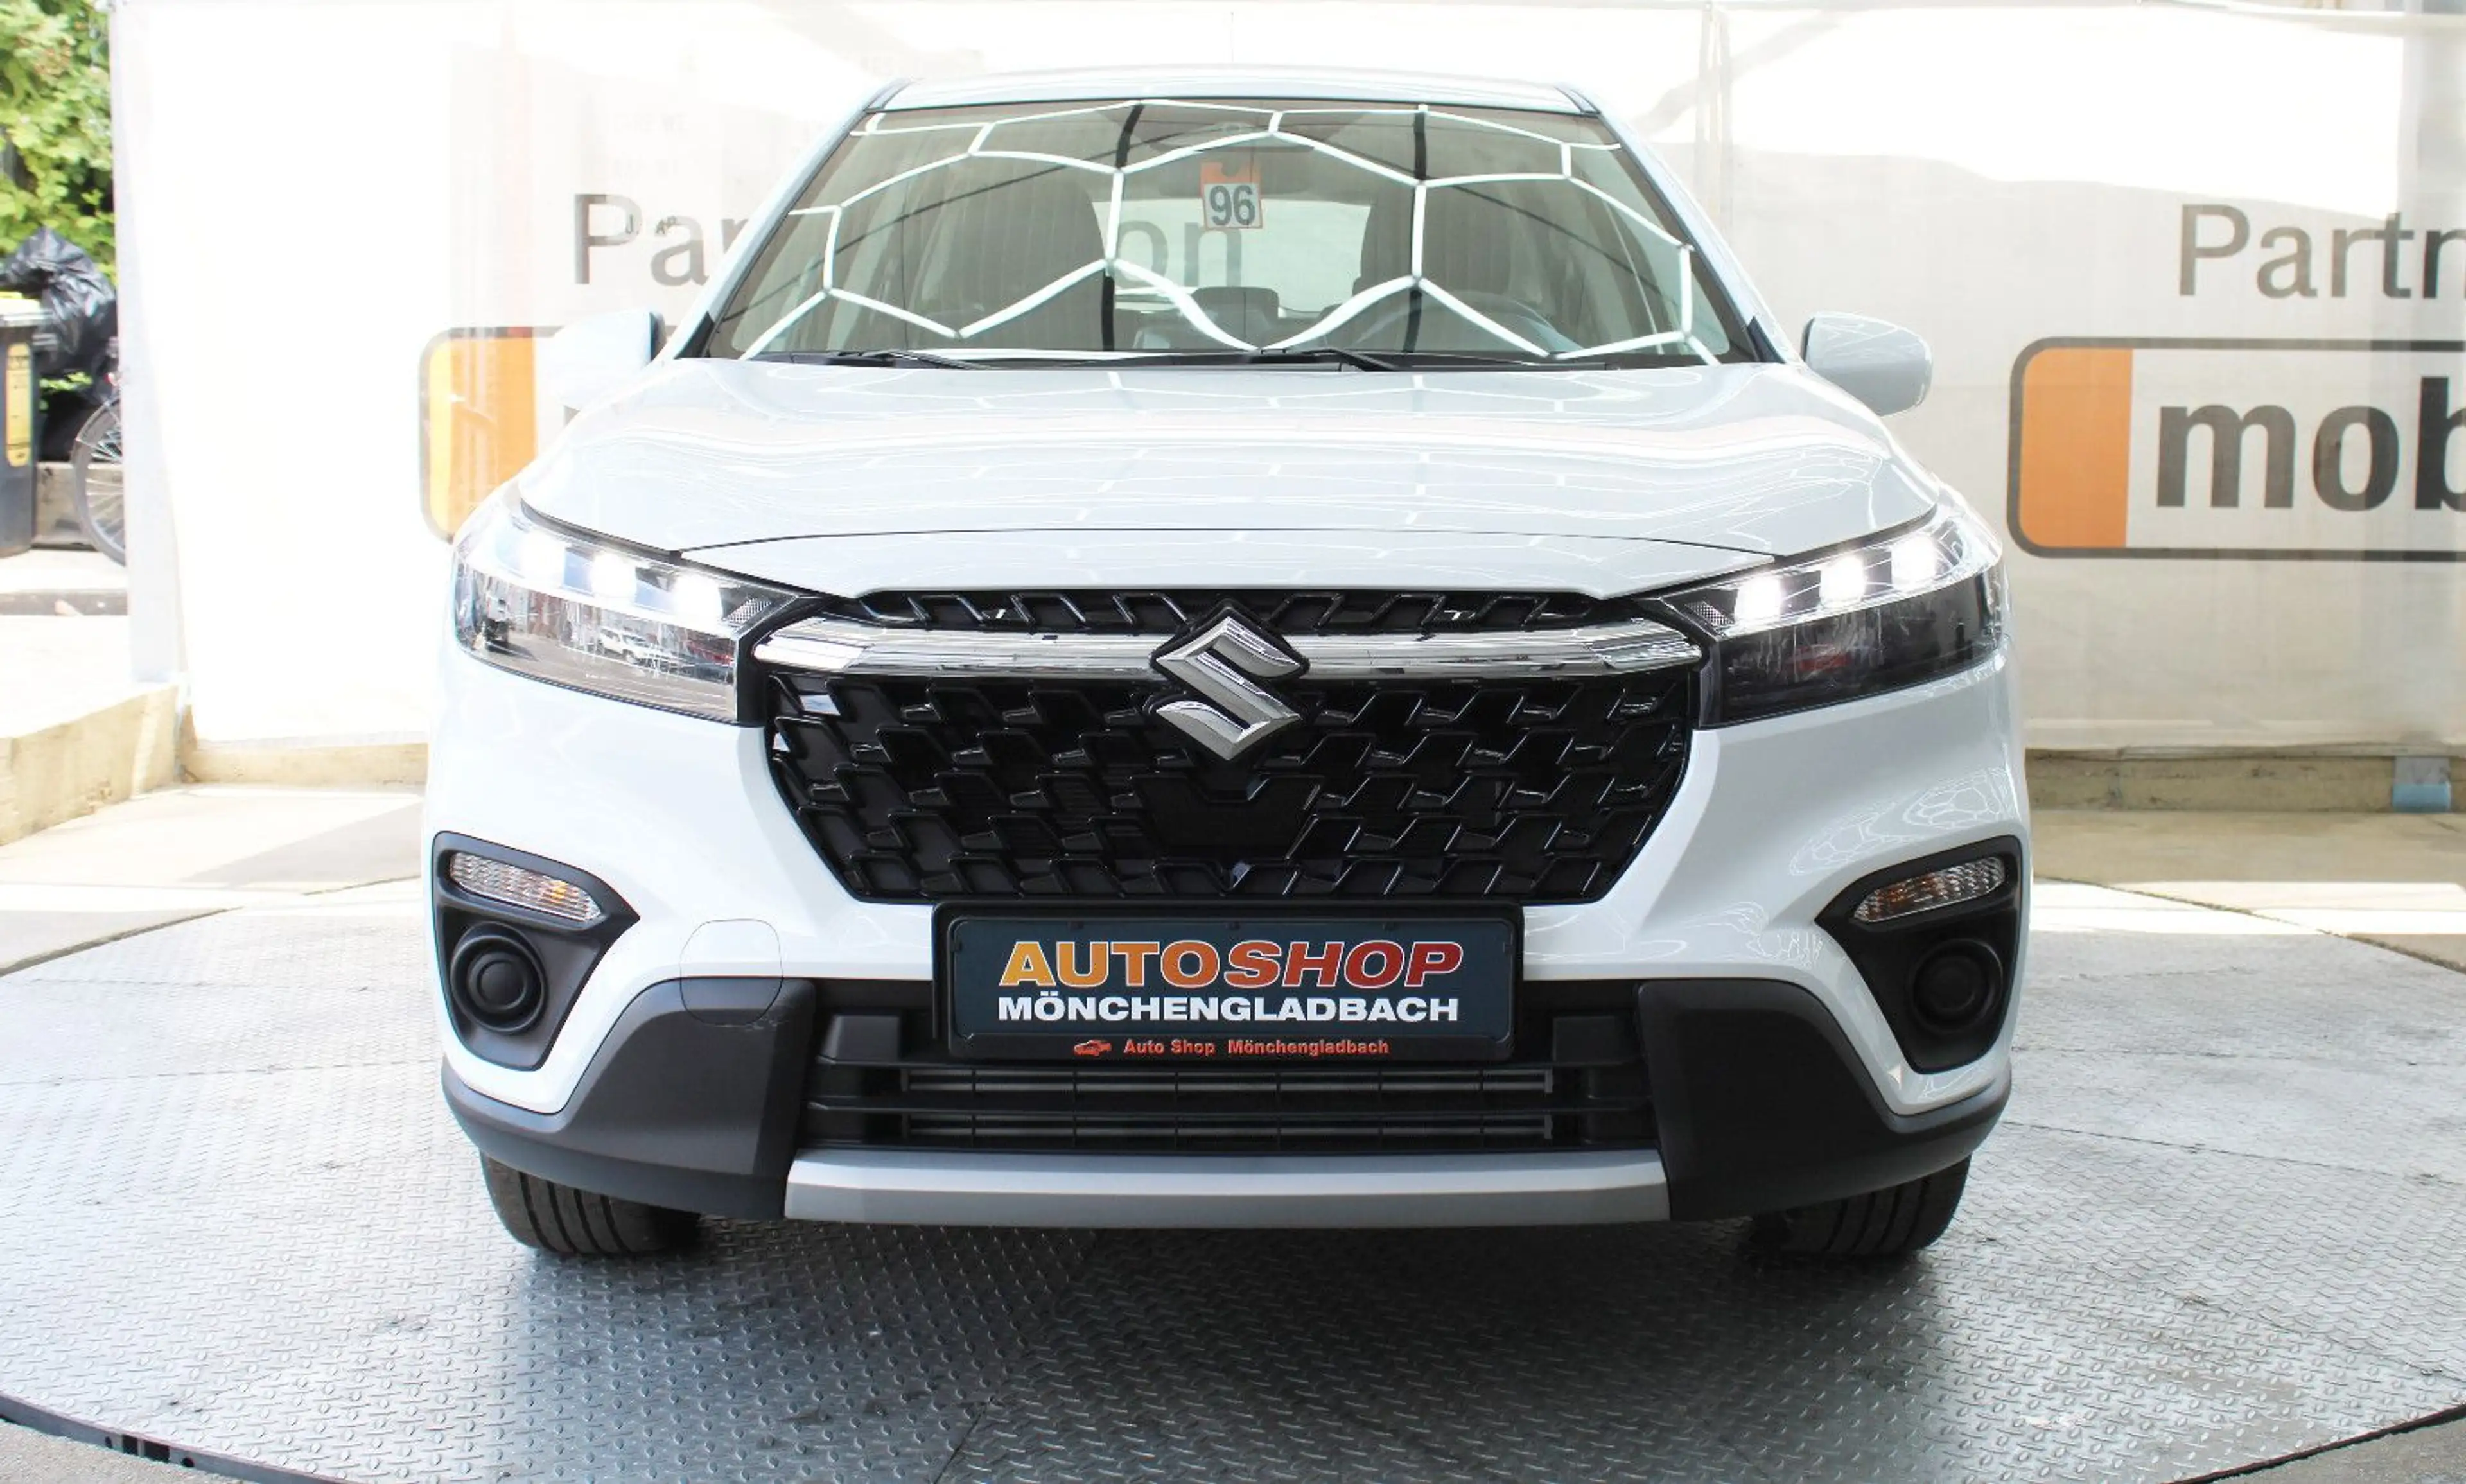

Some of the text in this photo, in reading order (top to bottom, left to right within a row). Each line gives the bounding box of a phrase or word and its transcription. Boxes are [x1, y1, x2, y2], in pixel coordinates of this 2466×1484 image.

[1210, 185, 1256, 226] 96
[998, 990, 1459, 1023] MÖNCHENGLADBACH
[1123, 1038, 1390, 1058] Auto Shop Mönchengladbach
